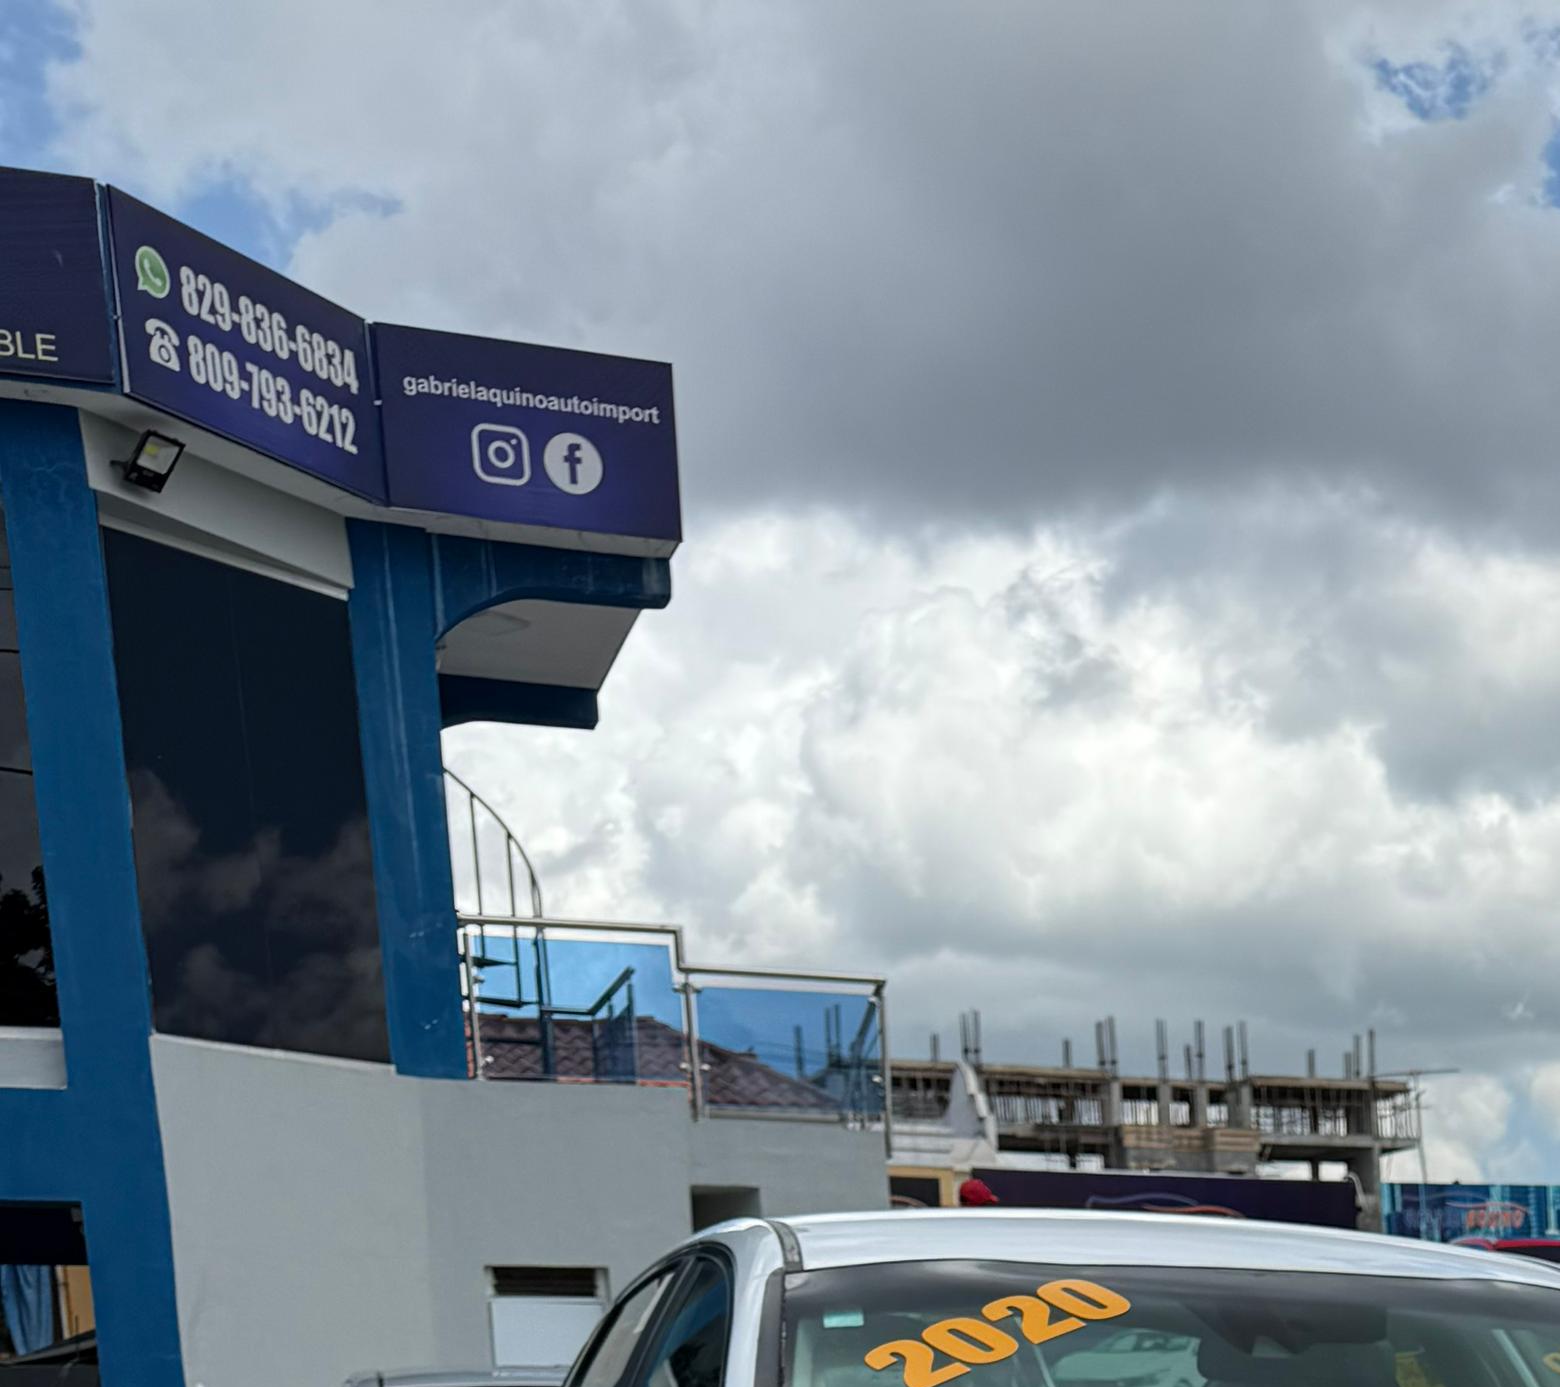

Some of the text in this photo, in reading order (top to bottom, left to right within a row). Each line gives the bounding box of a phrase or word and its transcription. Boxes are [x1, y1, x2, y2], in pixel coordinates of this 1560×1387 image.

[0, 329, 59, 361] BLE
[179, 266, 359, 394] 829-836-6834
[187, 335, 358, 454] 809-793-6212
[403, 375, 660, 424] gabrielaquinoautoimport
